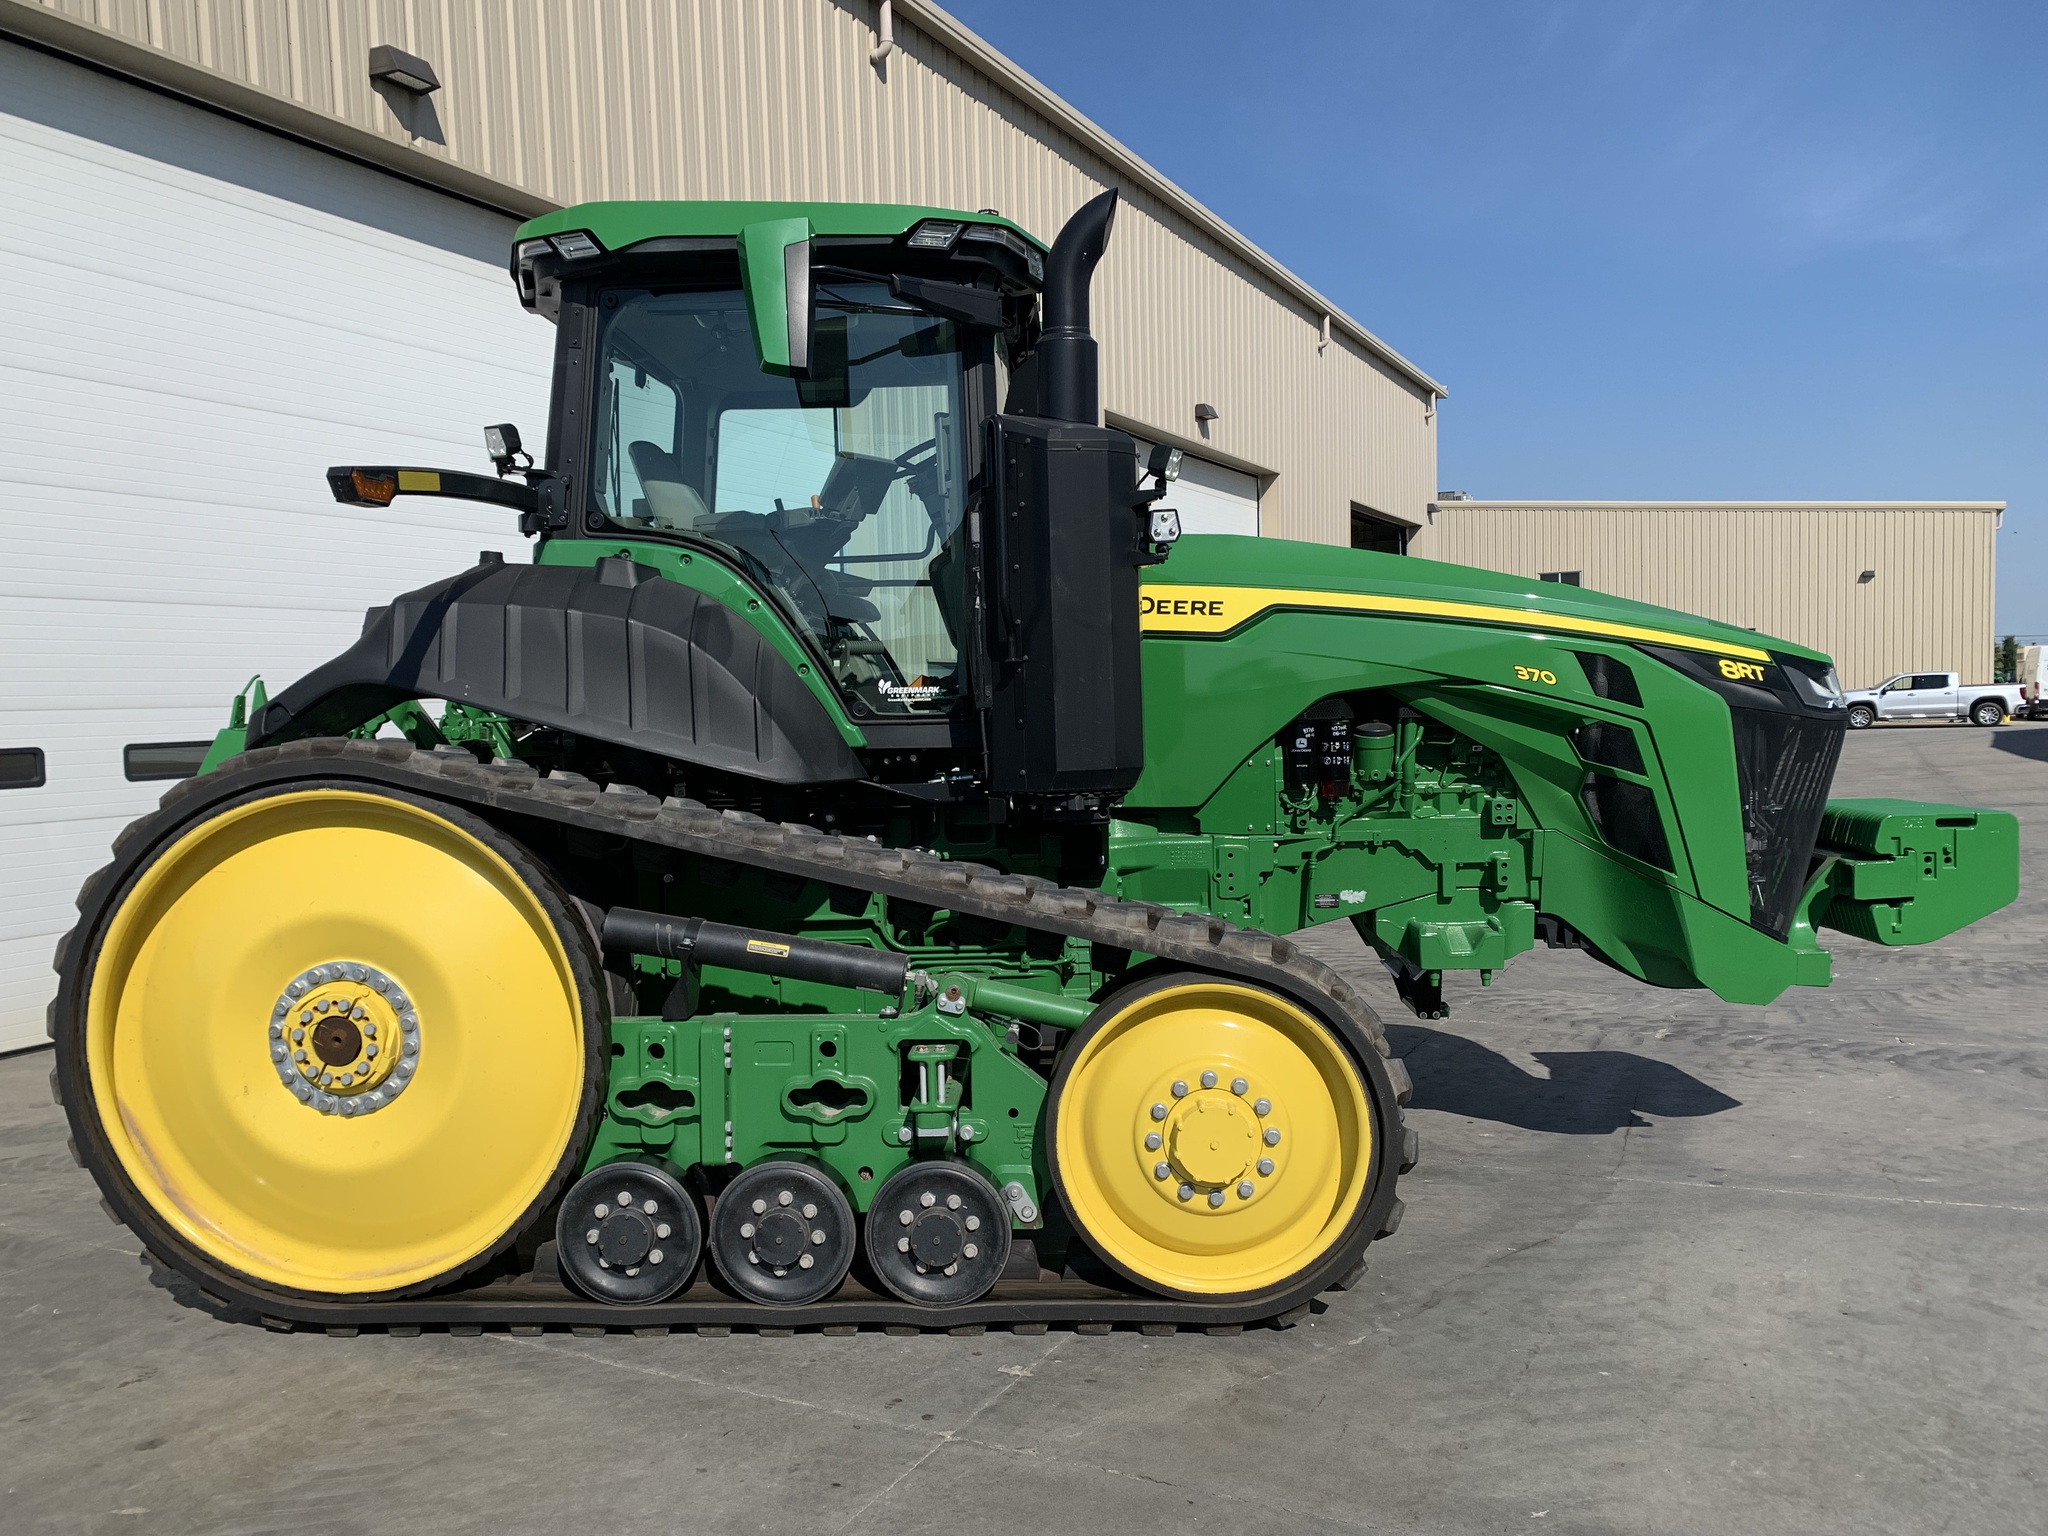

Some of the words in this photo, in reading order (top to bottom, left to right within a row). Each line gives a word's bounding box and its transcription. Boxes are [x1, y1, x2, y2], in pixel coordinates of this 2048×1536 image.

[1141, 596, 1224, 616] DEERE
[1514, 665, 1557, 685] 370
[1719, 659, 1764, 681] 8RT
[887, 686, 940, 694] GREENMARK
